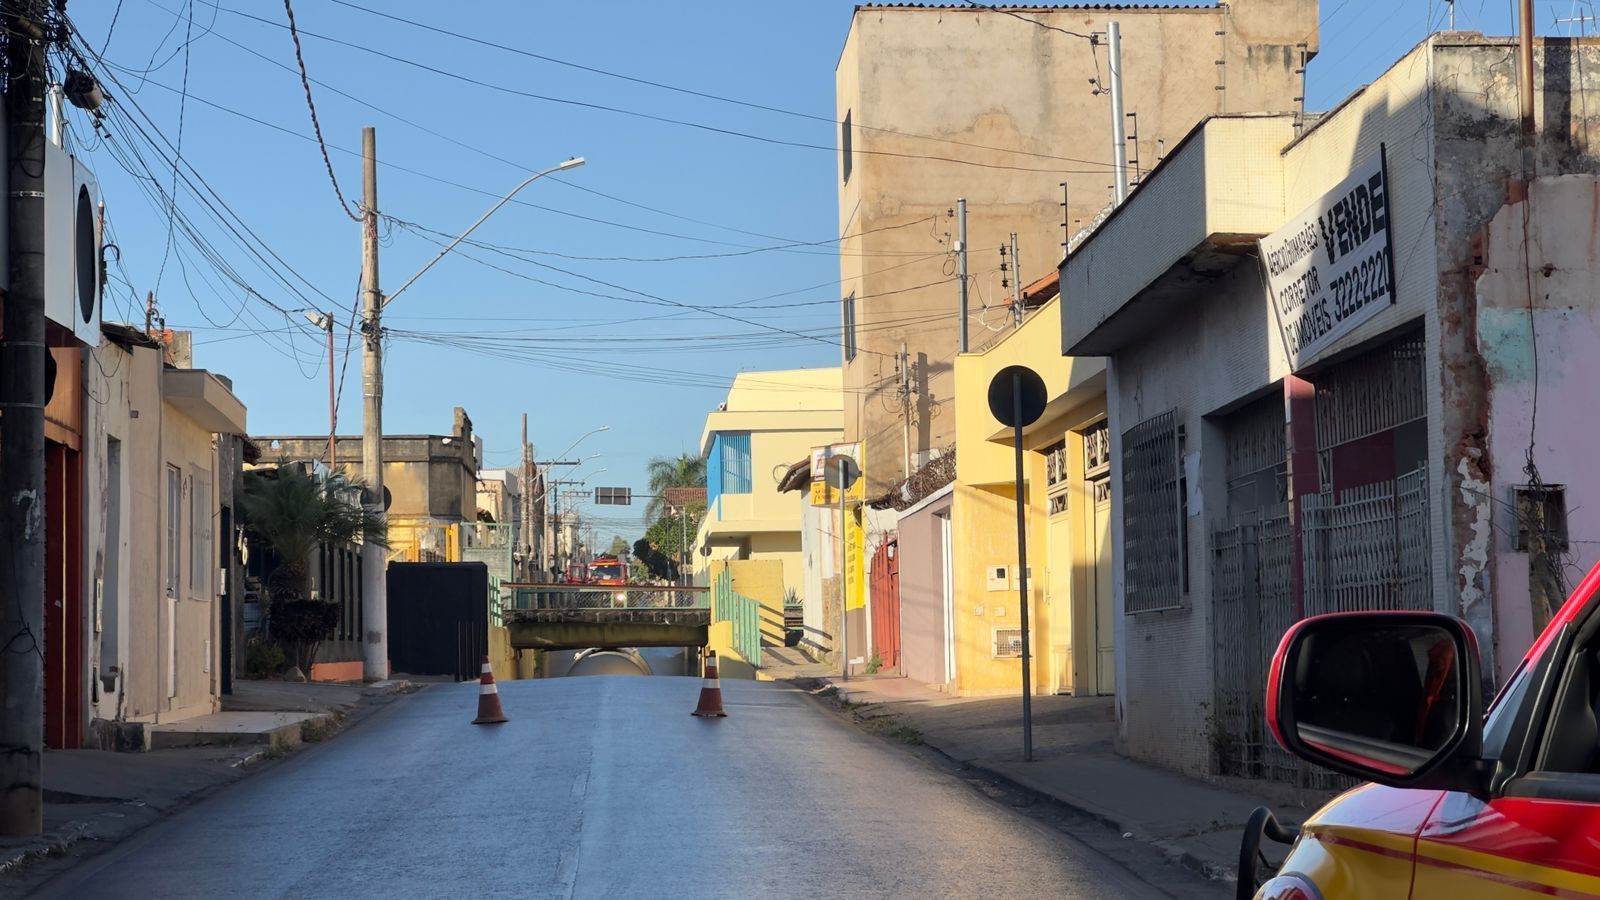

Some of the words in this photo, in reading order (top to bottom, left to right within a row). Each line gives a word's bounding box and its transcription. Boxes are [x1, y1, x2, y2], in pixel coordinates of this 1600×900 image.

[1318, 171, 1385, 264] VENDE
[1280, 266, 1320, 315] CORRETOR
[1285, 323, 1298, 355] DE
[1293, 298, 1331, 350] IMOVEIS
